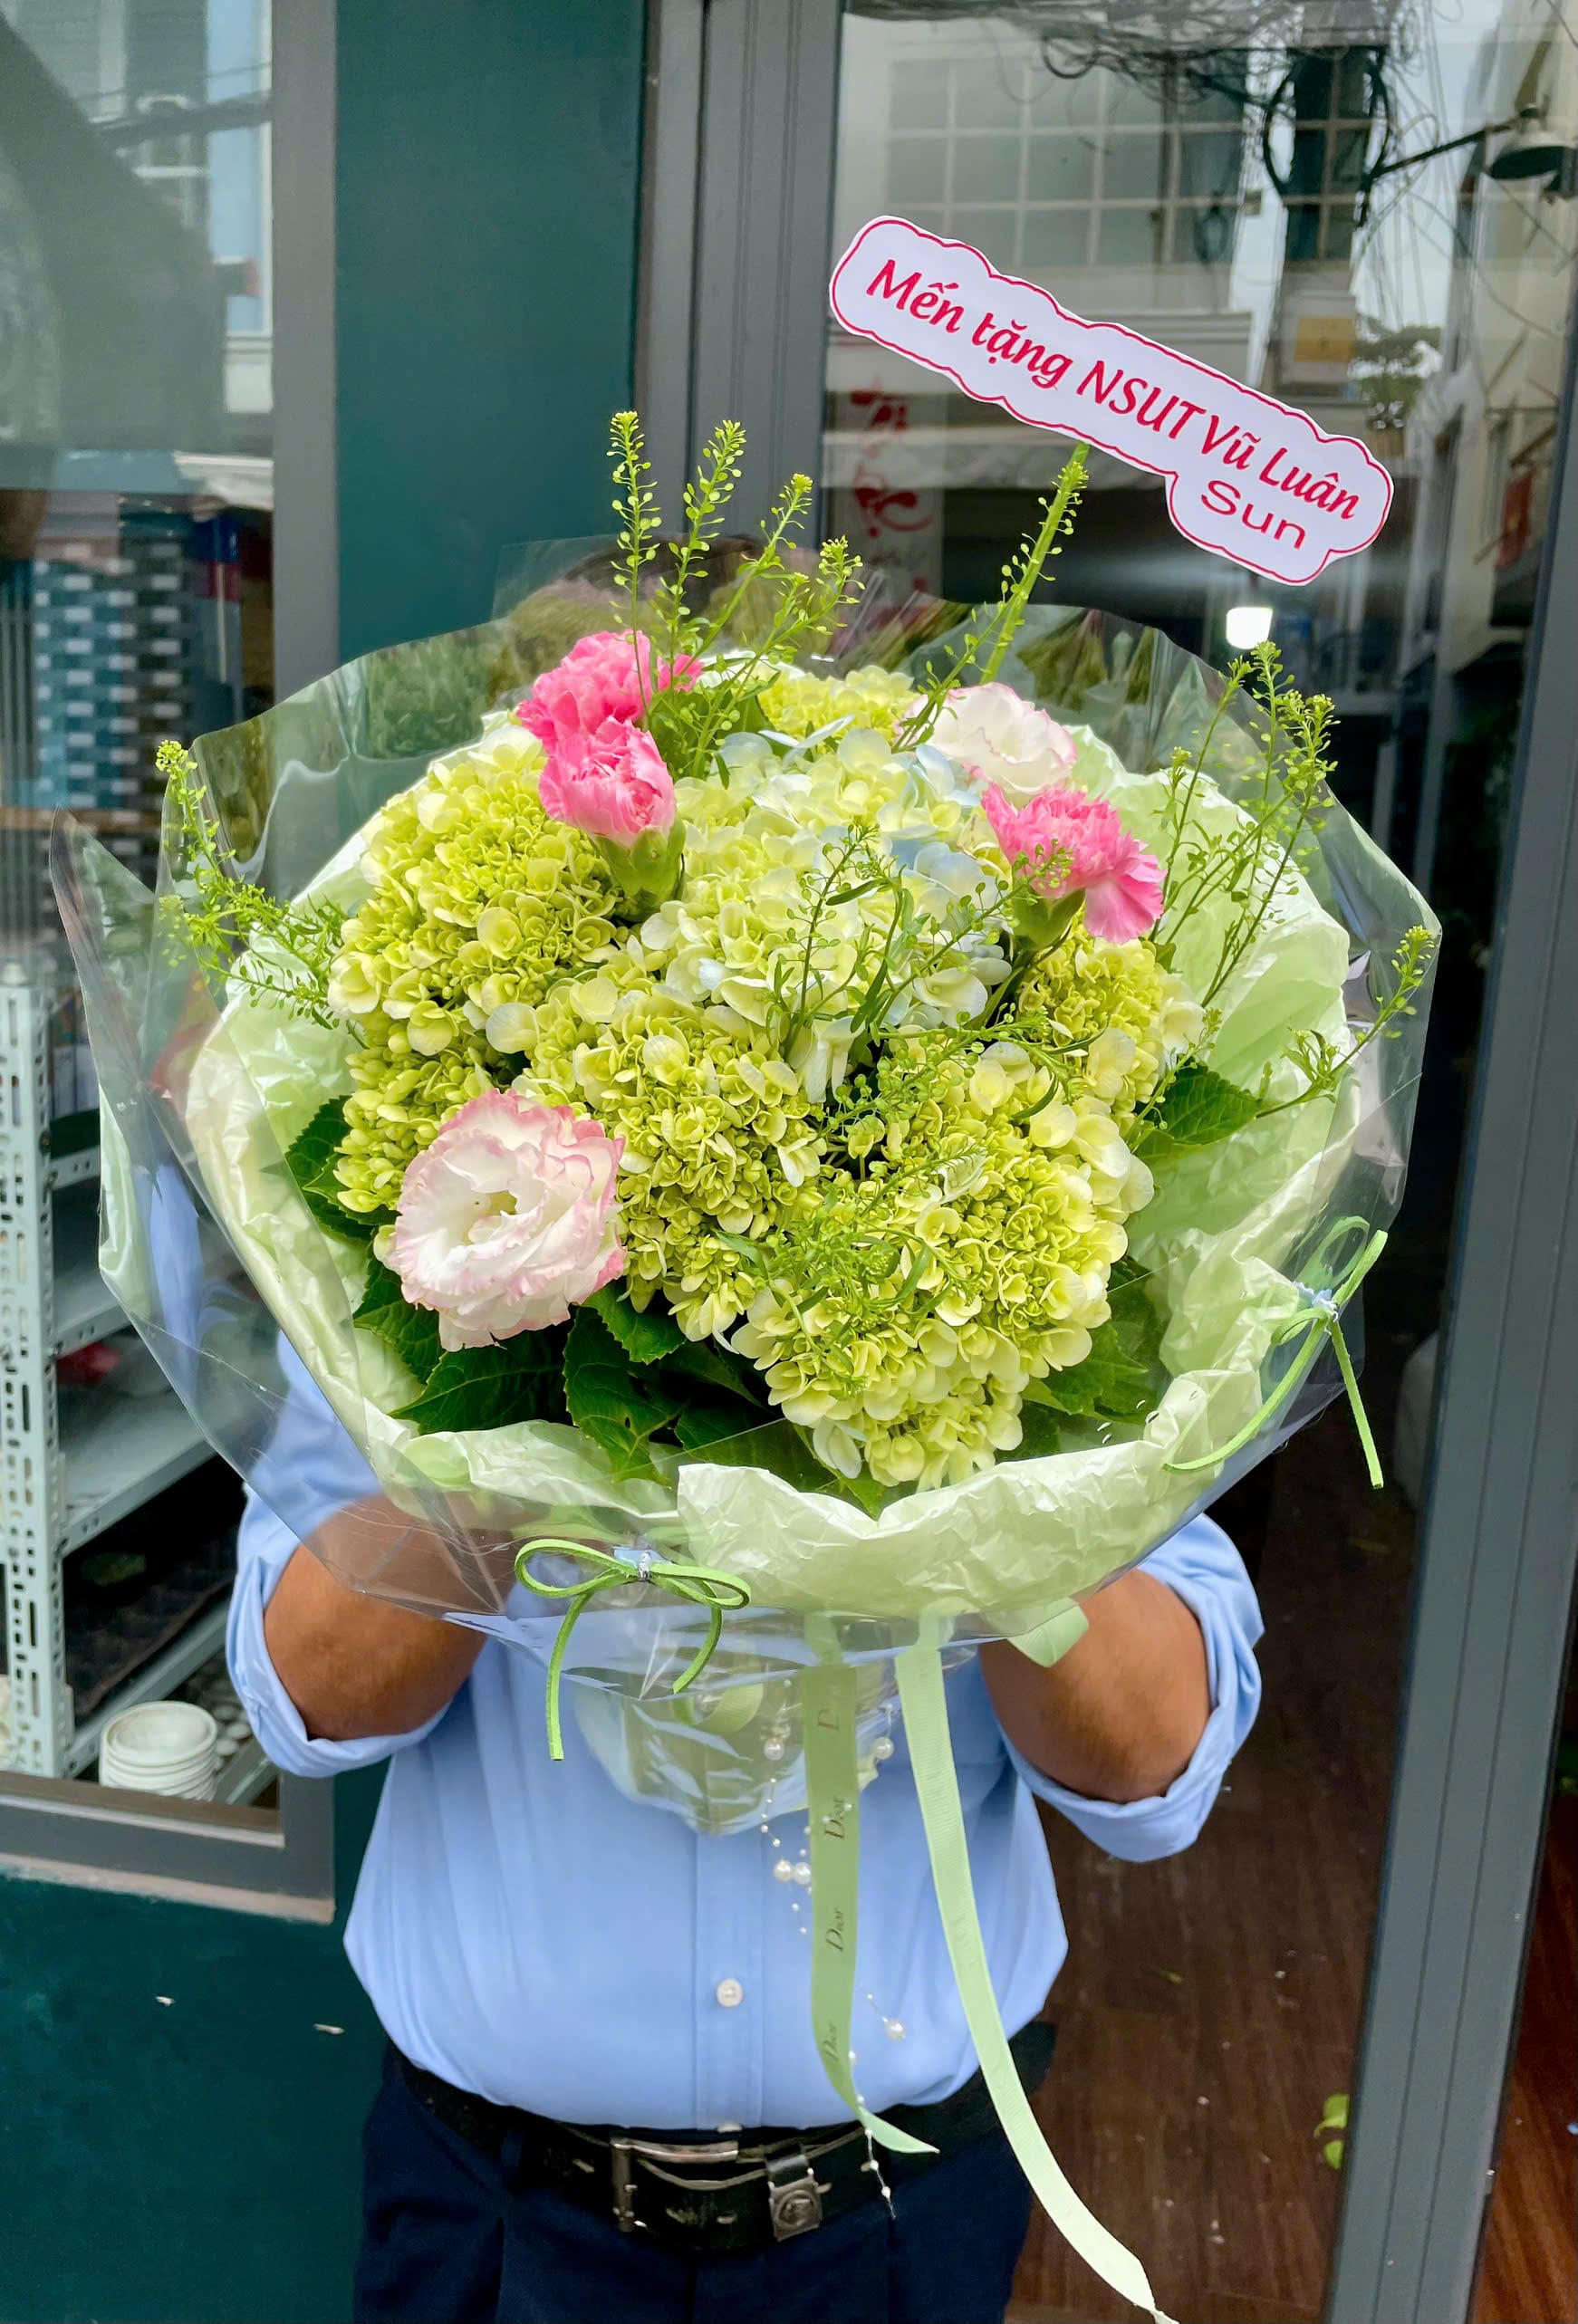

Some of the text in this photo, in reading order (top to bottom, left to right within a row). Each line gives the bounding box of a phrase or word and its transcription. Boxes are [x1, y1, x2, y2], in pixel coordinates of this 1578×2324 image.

[865, 259, 1360, 521] Mến tặng NSUT Vũ Luân
[1200, 479, 1306, 550] Sun
